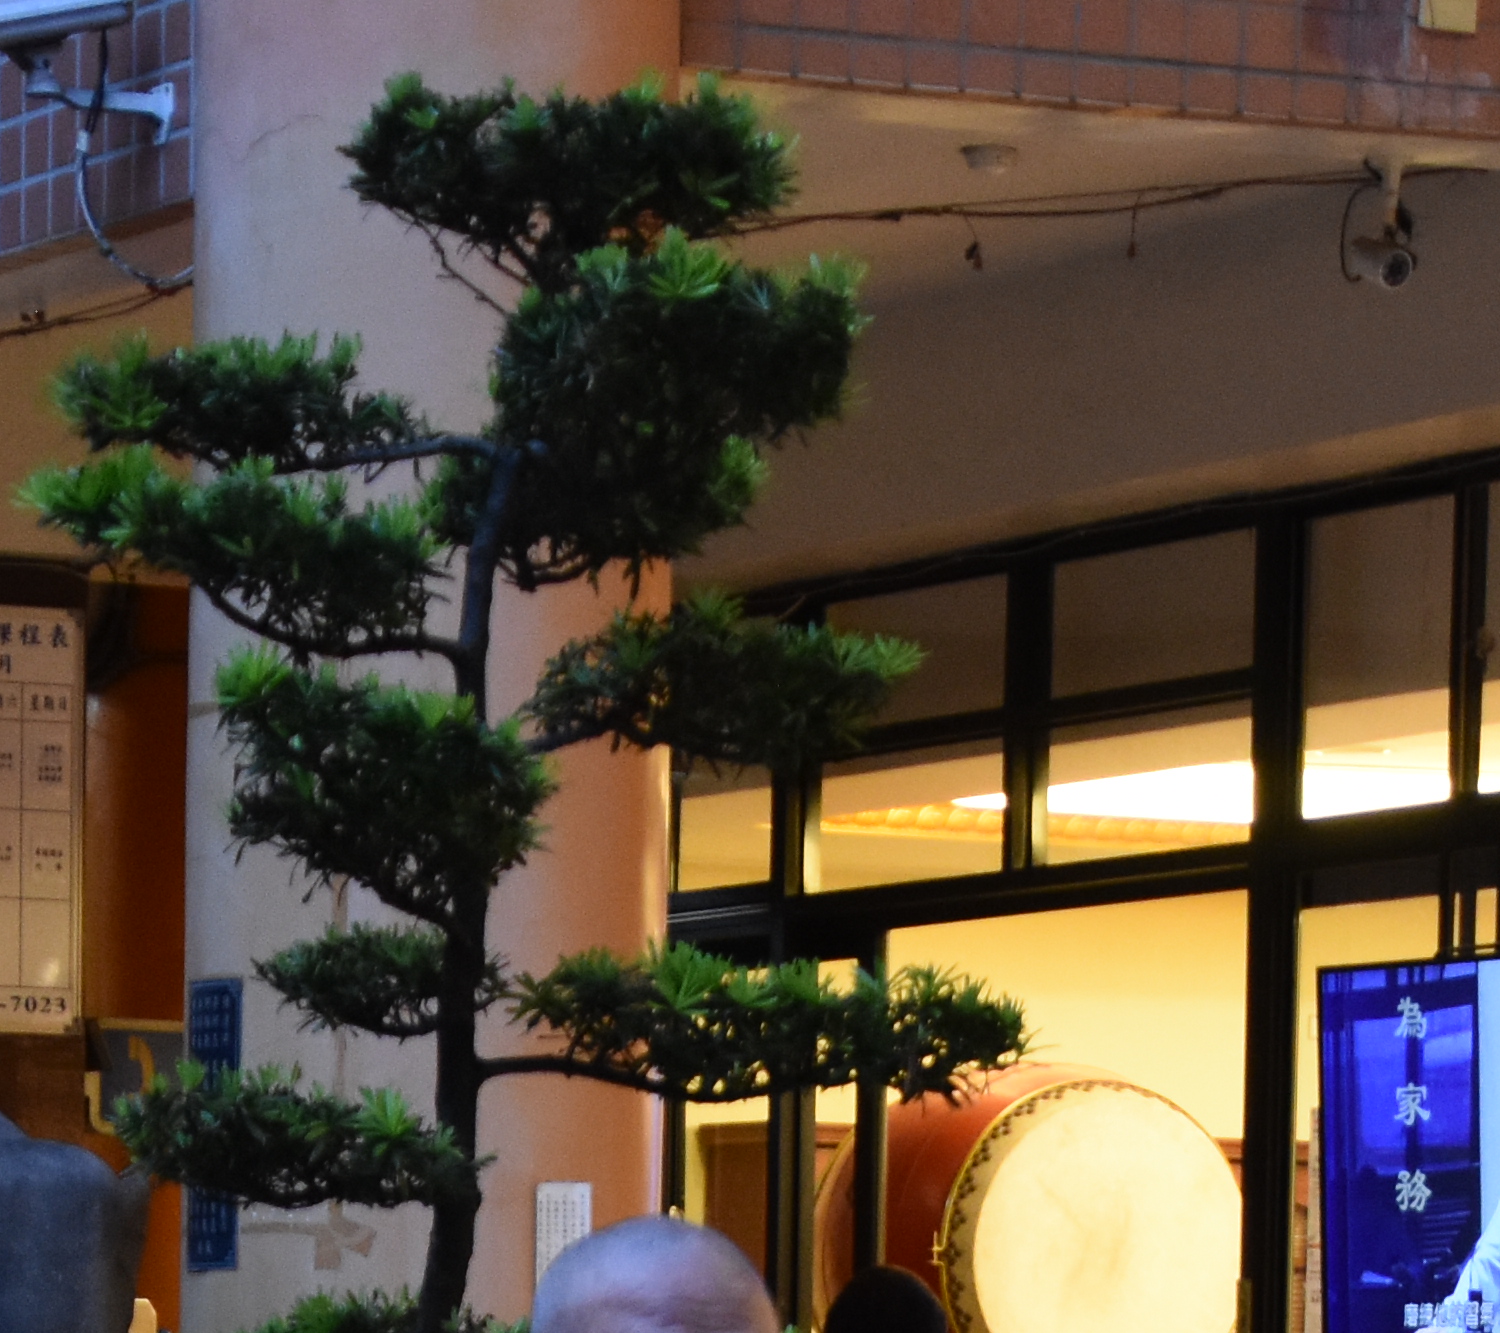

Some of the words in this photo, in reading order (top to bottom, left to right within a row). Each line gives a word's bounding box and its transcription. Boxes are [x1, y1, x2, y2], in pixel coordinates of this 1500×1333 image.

[29, 693, 67, 711] 星期日
[1394, 995, 1434, 1212] 為家務
